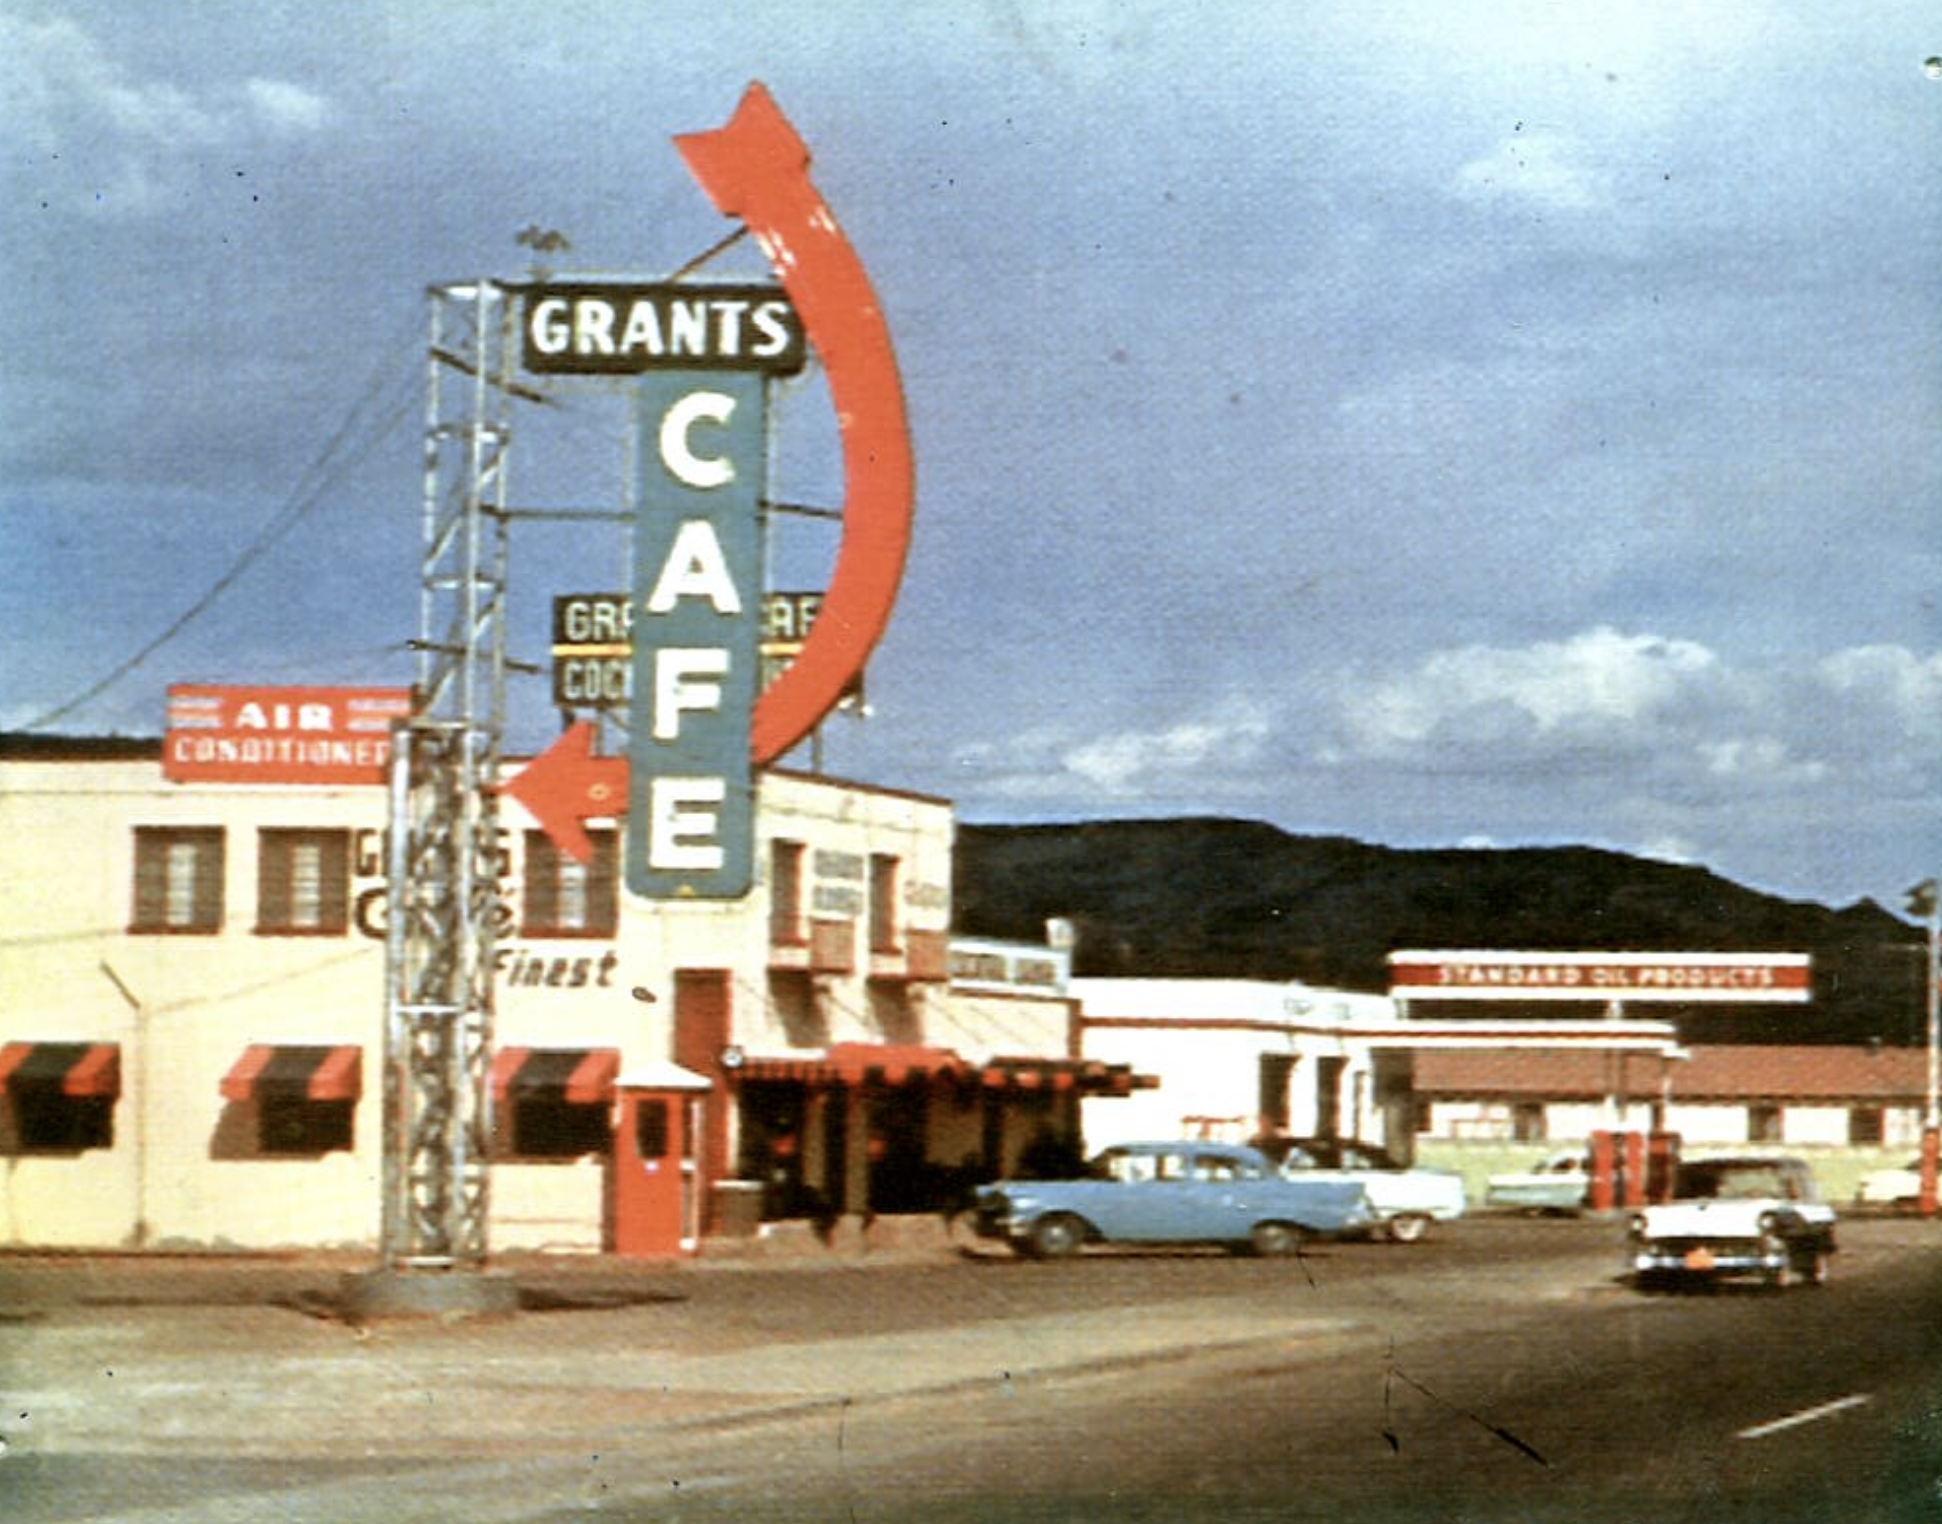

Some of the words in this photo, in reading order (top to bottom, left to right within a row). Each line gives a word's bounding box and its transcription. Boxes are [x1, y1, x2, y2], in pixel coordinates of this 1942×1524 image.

[531, 299, 790, 356] GRANTS
[647, 391, 742, 869] CAFE
[236, 702, 333, 731] AIR
[1438, 966, 1582, 986] STANDARD
[1591, 967, 1629, 986] OIL
[1638, 967, 1773, 987] PRODUCTS
